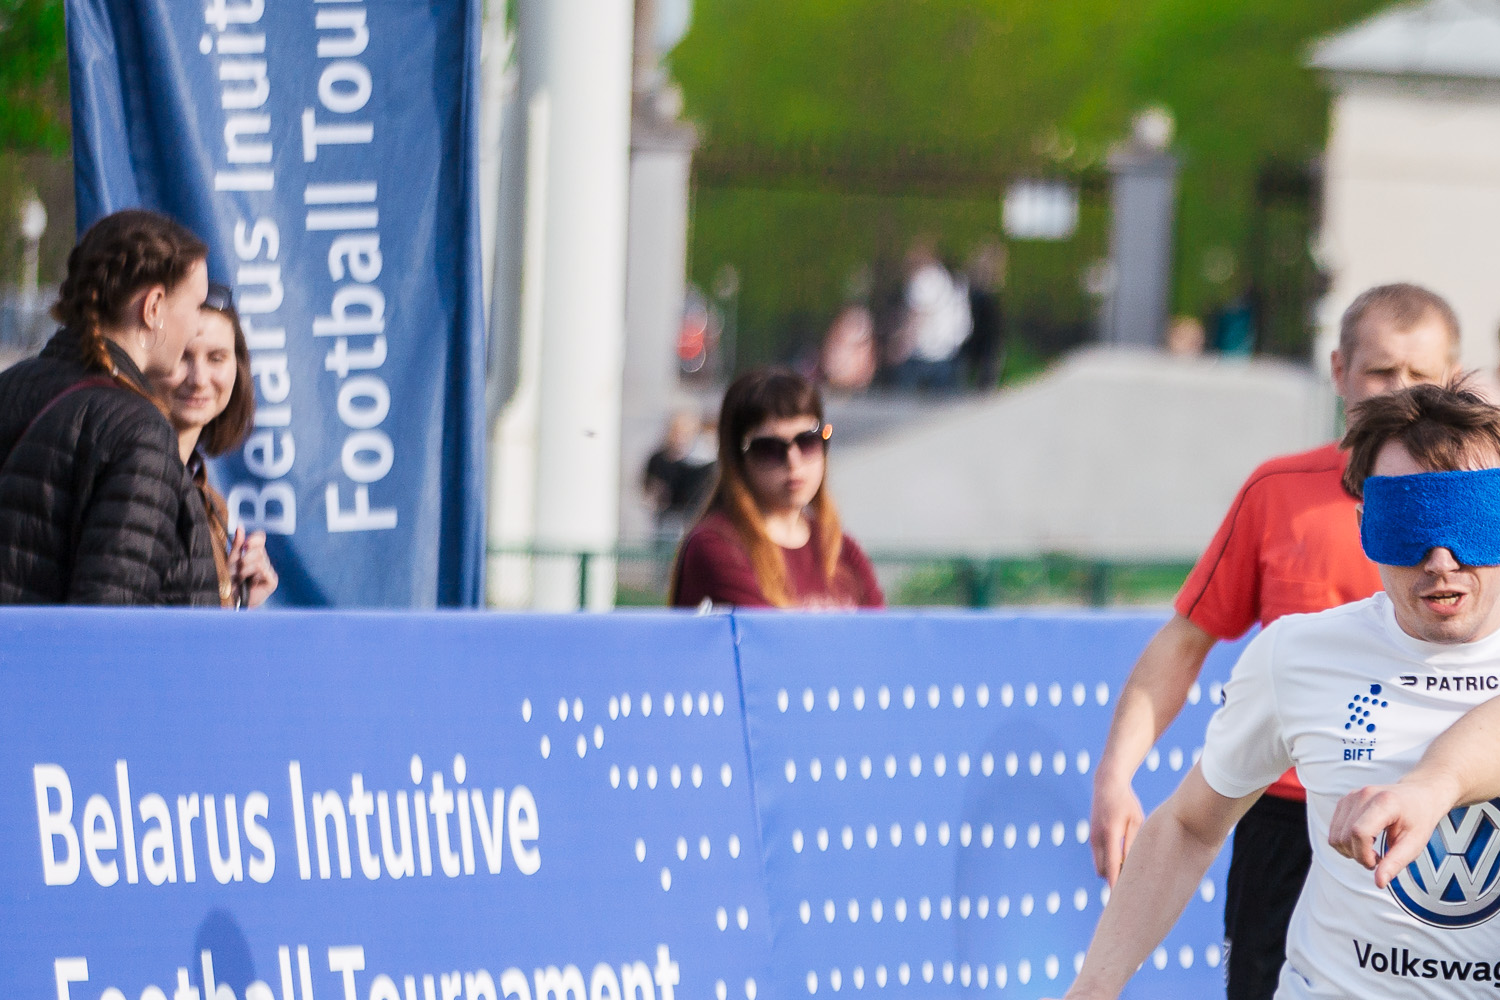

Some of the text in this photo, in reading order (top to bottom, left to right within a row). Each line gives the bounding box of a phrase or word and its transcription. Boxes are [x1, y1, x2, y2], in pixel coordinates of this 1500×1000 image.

[228, 218, 297, 536] Belarus
[304, 181, 398, 533] Football
[33, 753, 542, 887] Belarus Intuitive
[1343, 748, 1375, 761] BIFT
